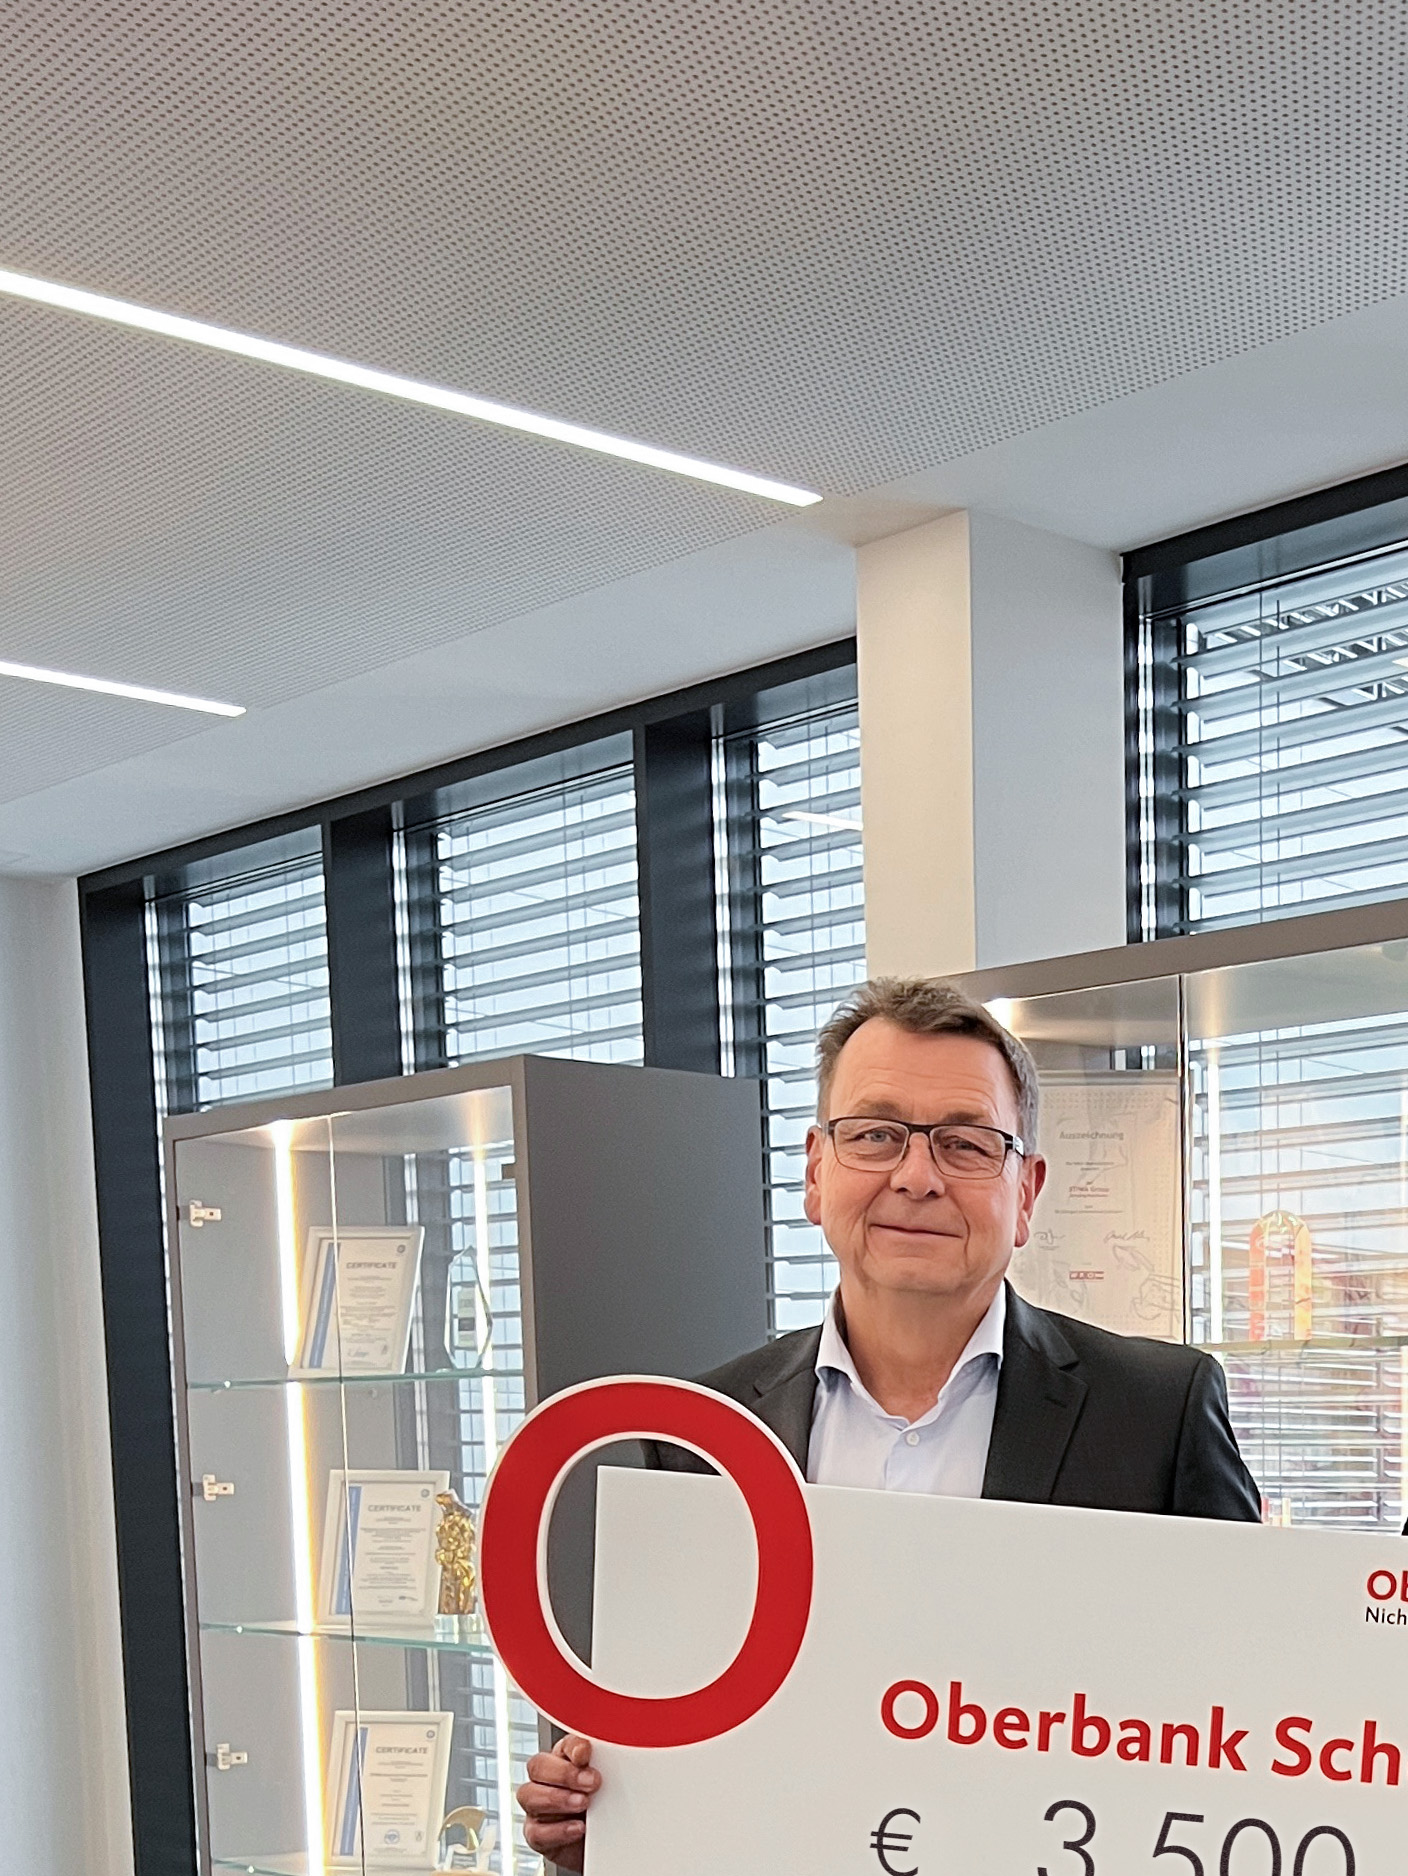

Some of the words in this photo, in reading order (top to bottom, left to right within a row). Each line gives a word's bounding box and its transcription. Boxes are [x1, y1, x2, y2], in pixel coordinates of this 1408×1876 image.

[1059, 1131, 1125, 1141] Auszeichnung
[346, 1261, 397, 1270] CERTIFICATE
[367, 1504, 422, 1513] CERTIFICATE
[880, 1679, 1248, 1772] Oberbank
[375, 1746, 428, 1755] CERTIFICATE
